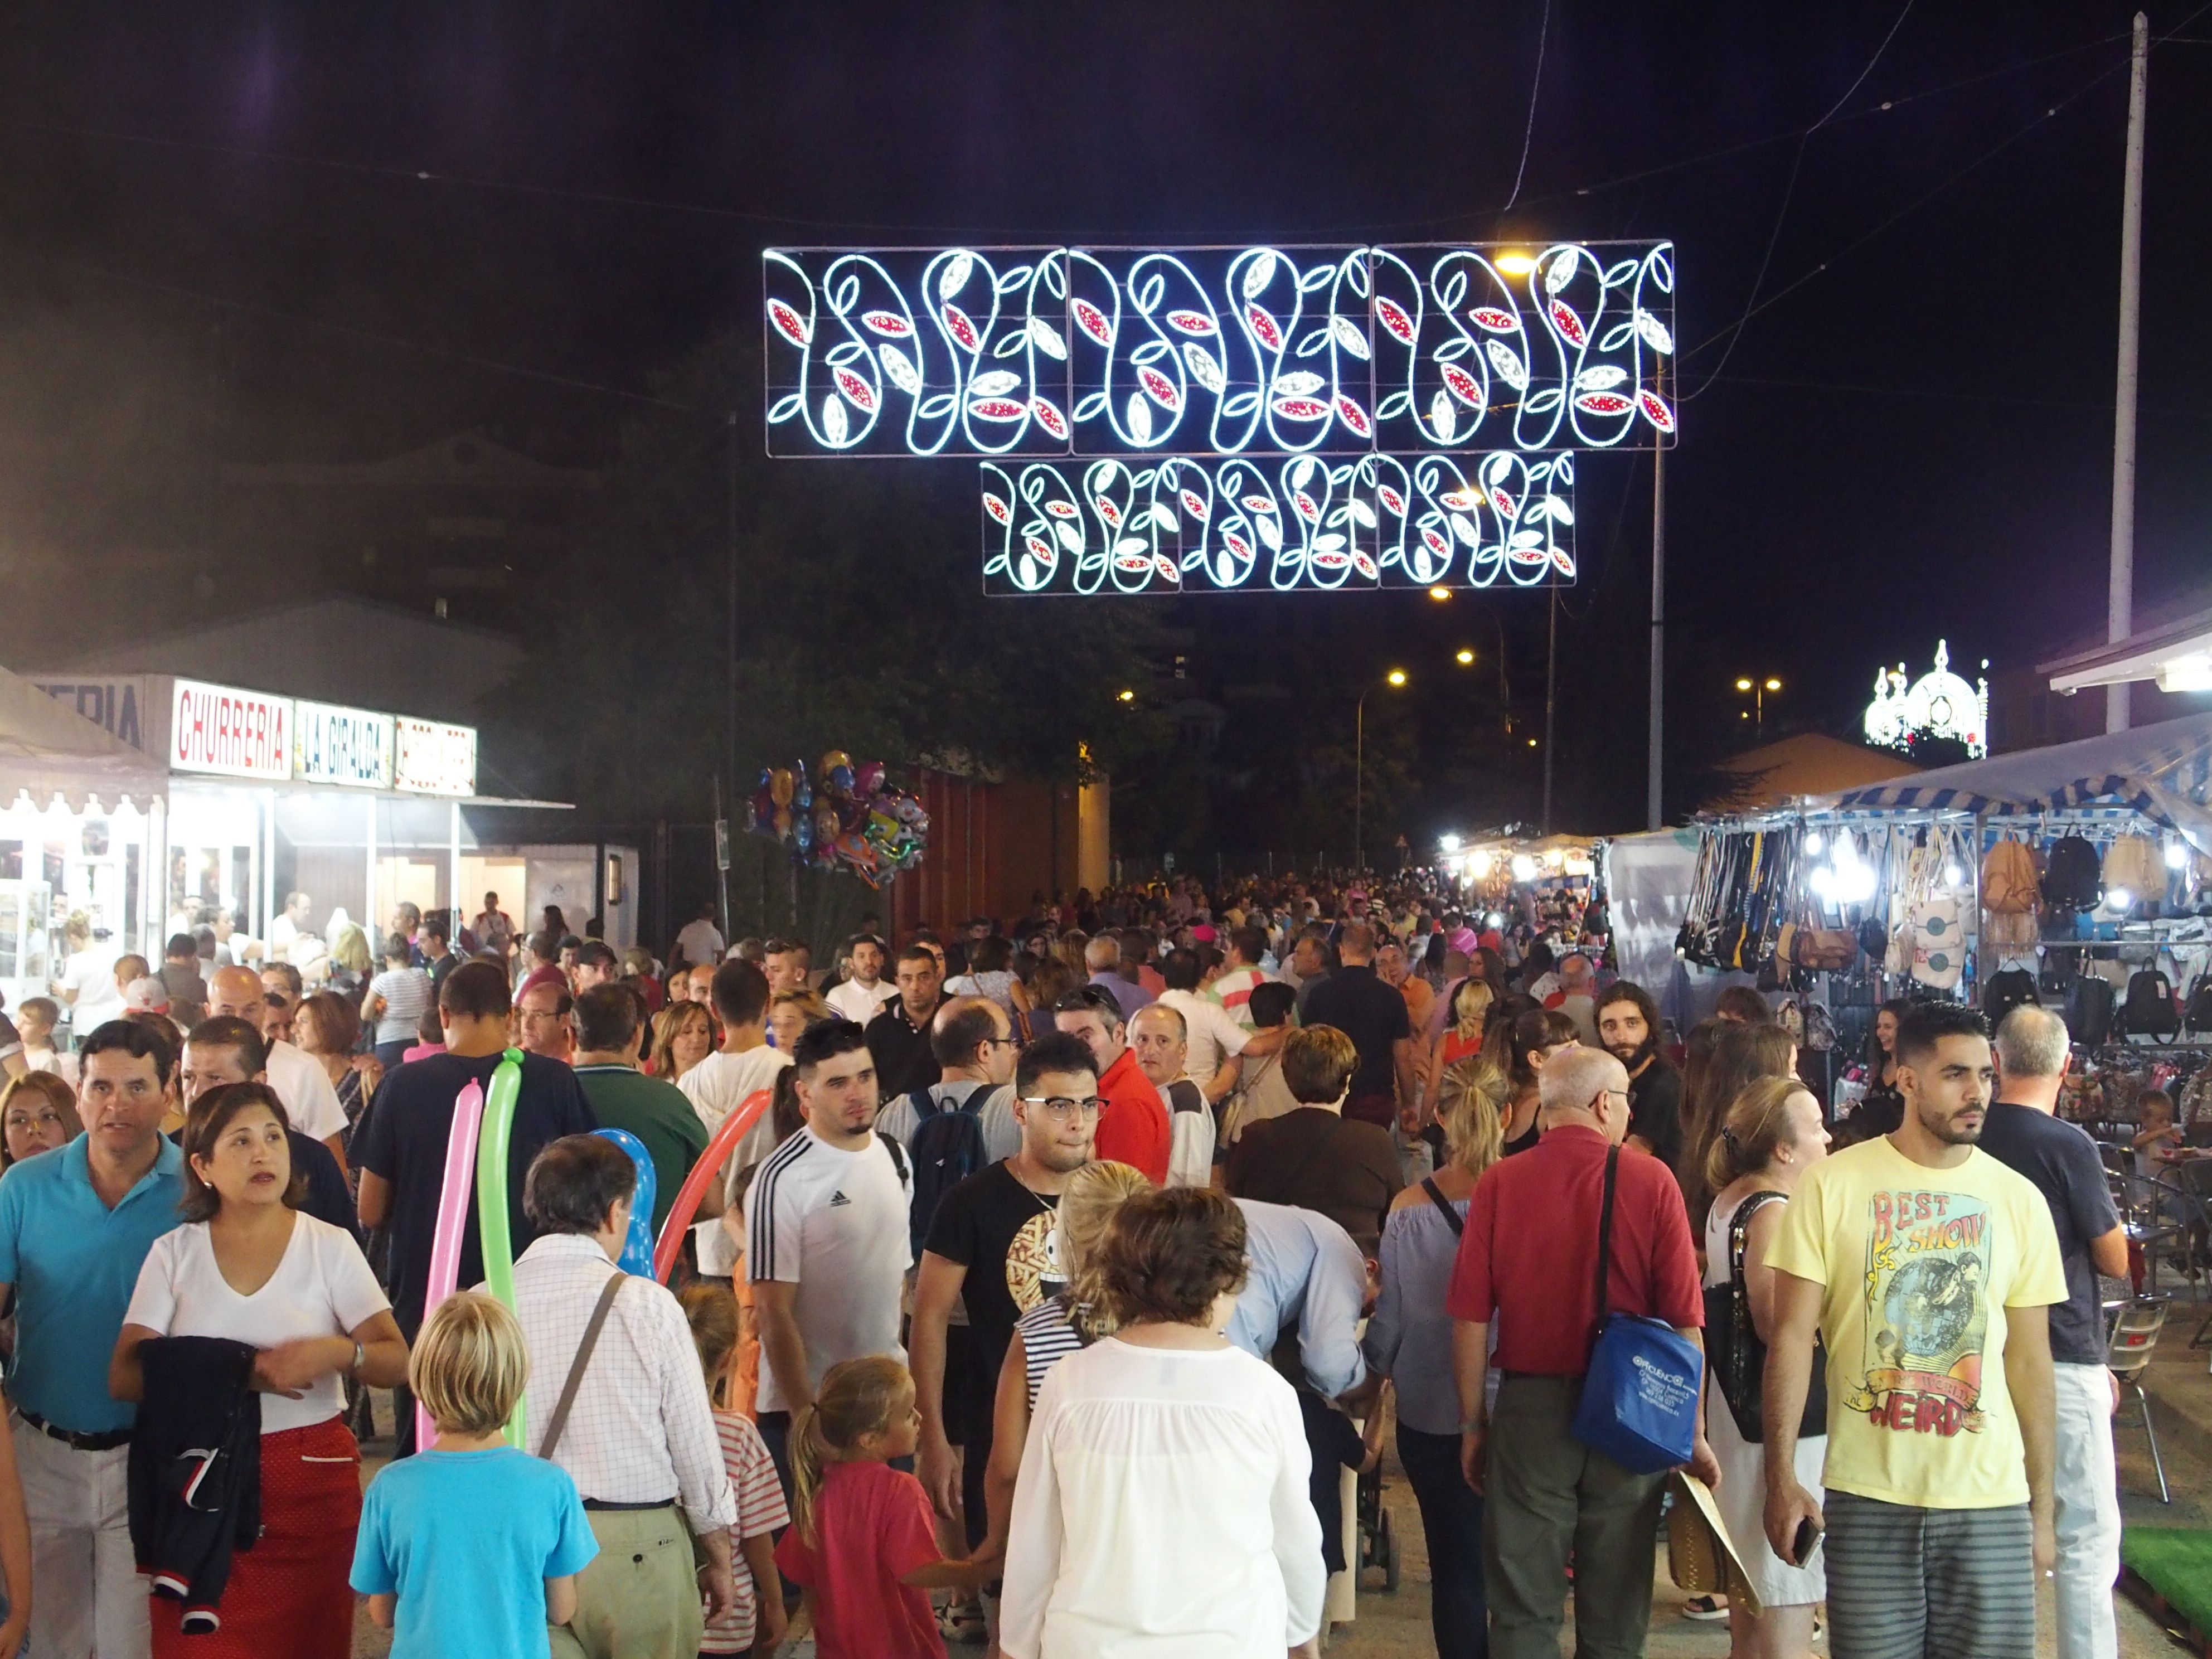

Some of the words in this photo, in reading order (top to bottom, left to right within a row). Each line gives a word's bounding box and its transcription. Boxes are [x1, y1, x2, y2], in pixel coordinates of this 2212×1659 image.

[178, 690, 283, 771] CHURRERIA
[304, 712, 321, 773] LA
[329, 716, 381, 780] GIRALDA
[1873, 1191, 1950, 1253] BEST
[1907, 1211, 1986, 1253] SHOW
